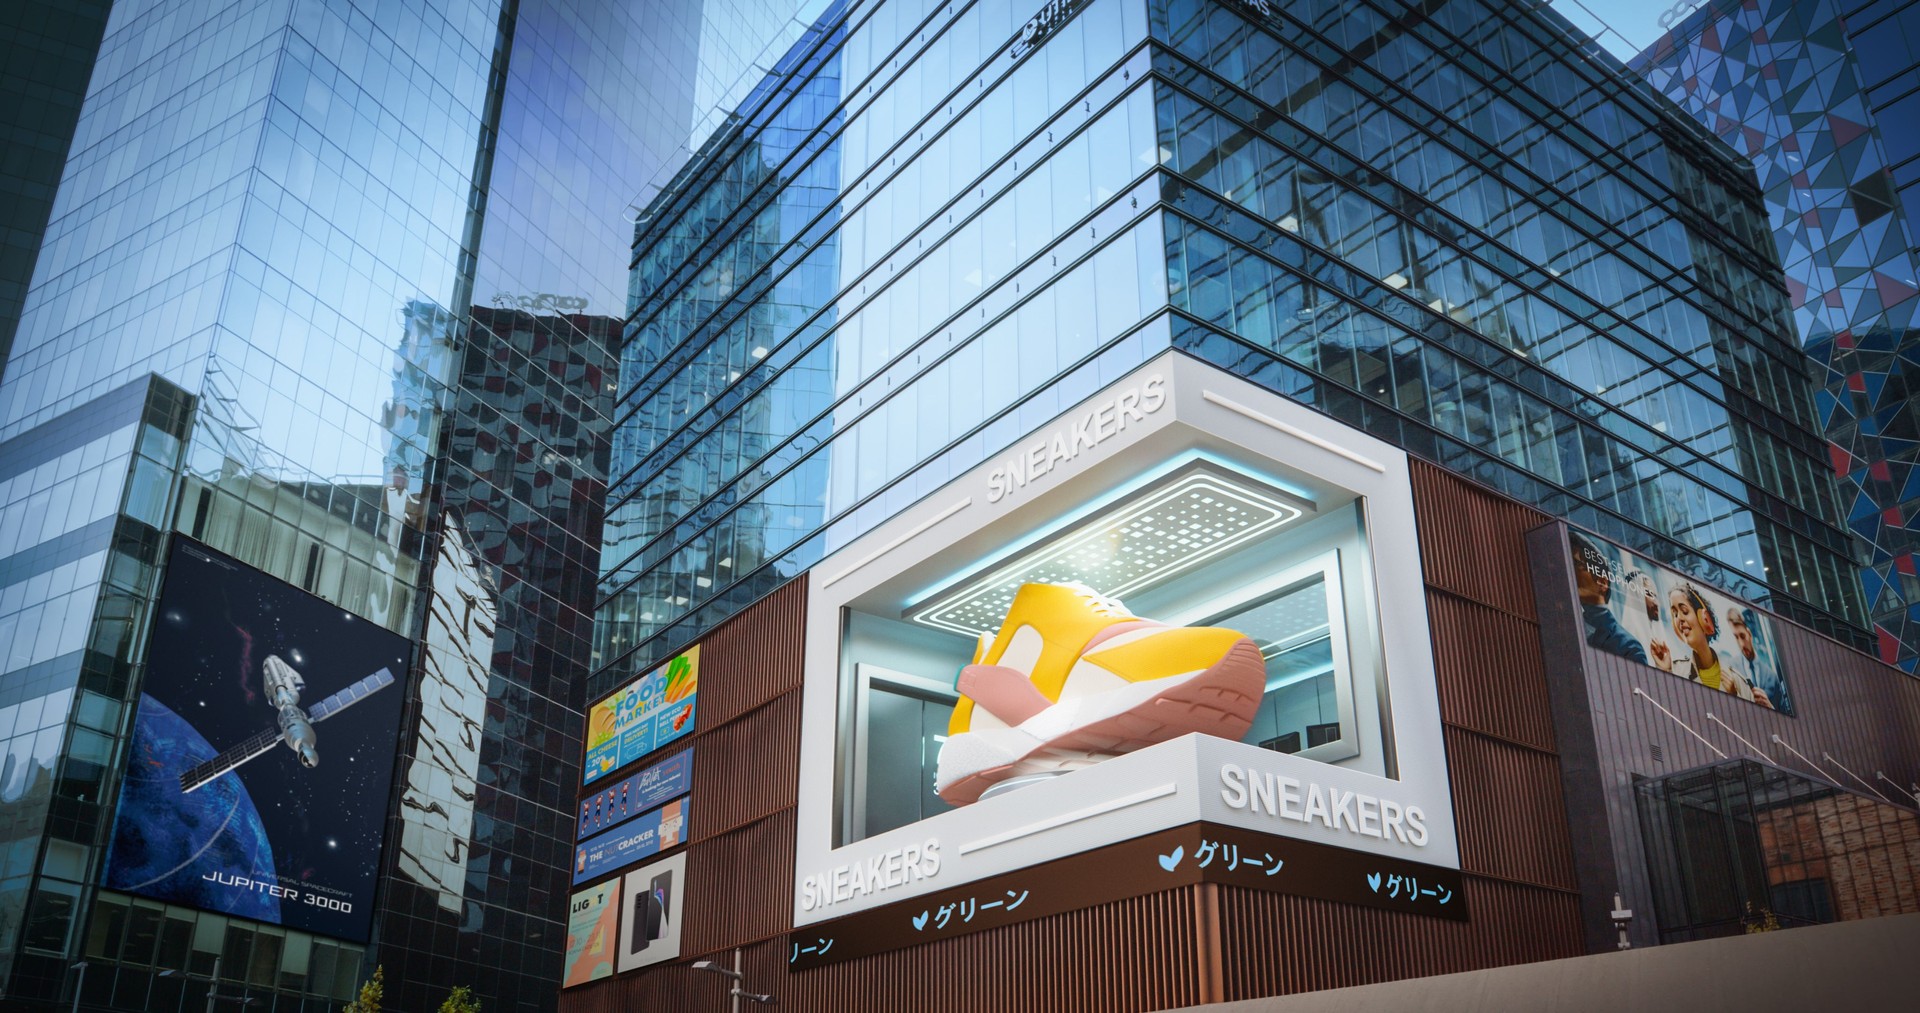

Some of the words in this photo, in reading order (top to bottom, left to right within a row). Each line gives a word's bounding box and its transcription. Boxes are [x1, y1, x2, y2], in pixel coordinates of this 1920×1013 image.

[987, 374, 1166, 503] SNEAKERS
[1586, 562, 1655, 600] HEADPHONES
[615, 692, 666, 730] MARKET
[616, 677, 668, 717] FOOD
[1220, 764, 1428, 847] SNEAKERS
[590, 850, 603, 863] THE
[802, 838, 942, 911] SNEAKERS
[1194, 839, 1284, 876] グリーン
[202, 871, 298, 901] JUPITER
[304, 893, 352, 913] 3000
[252, 871, 300, 886] UNIVERSAL
[301, 881, 353, 898] SPACECRAFT
[573, 893, 603, 913] LIGT
[1386, 873, 1452, 904] グリーン
[934, 890, 1029, 930] グリーン
